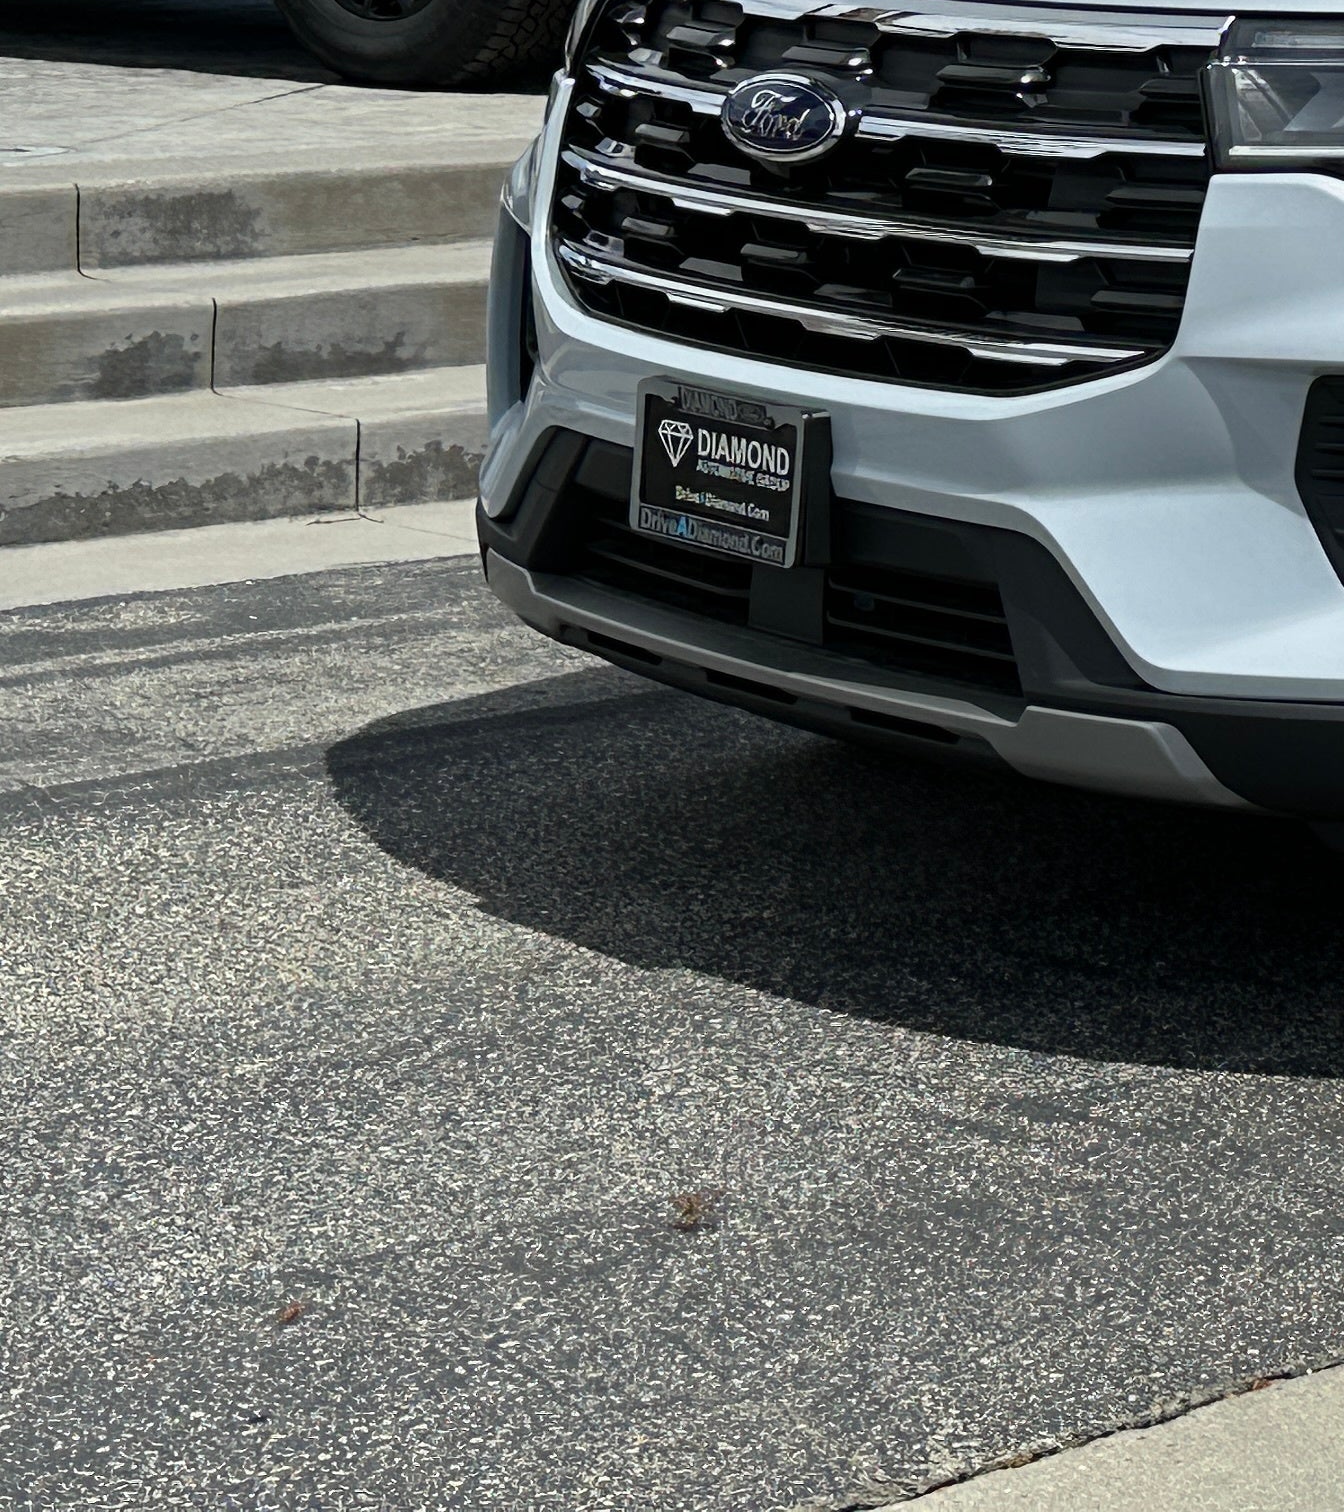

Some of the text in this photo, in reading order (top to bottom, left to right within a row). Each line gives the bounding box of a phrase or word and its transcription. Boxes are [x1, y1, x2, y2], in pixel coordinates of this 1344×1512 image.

[741, 89, 811, 141] Ford
[697, 427, 791, 476] DIAMOND
[640, 507, 784, 564] DriveADiamond.Com
